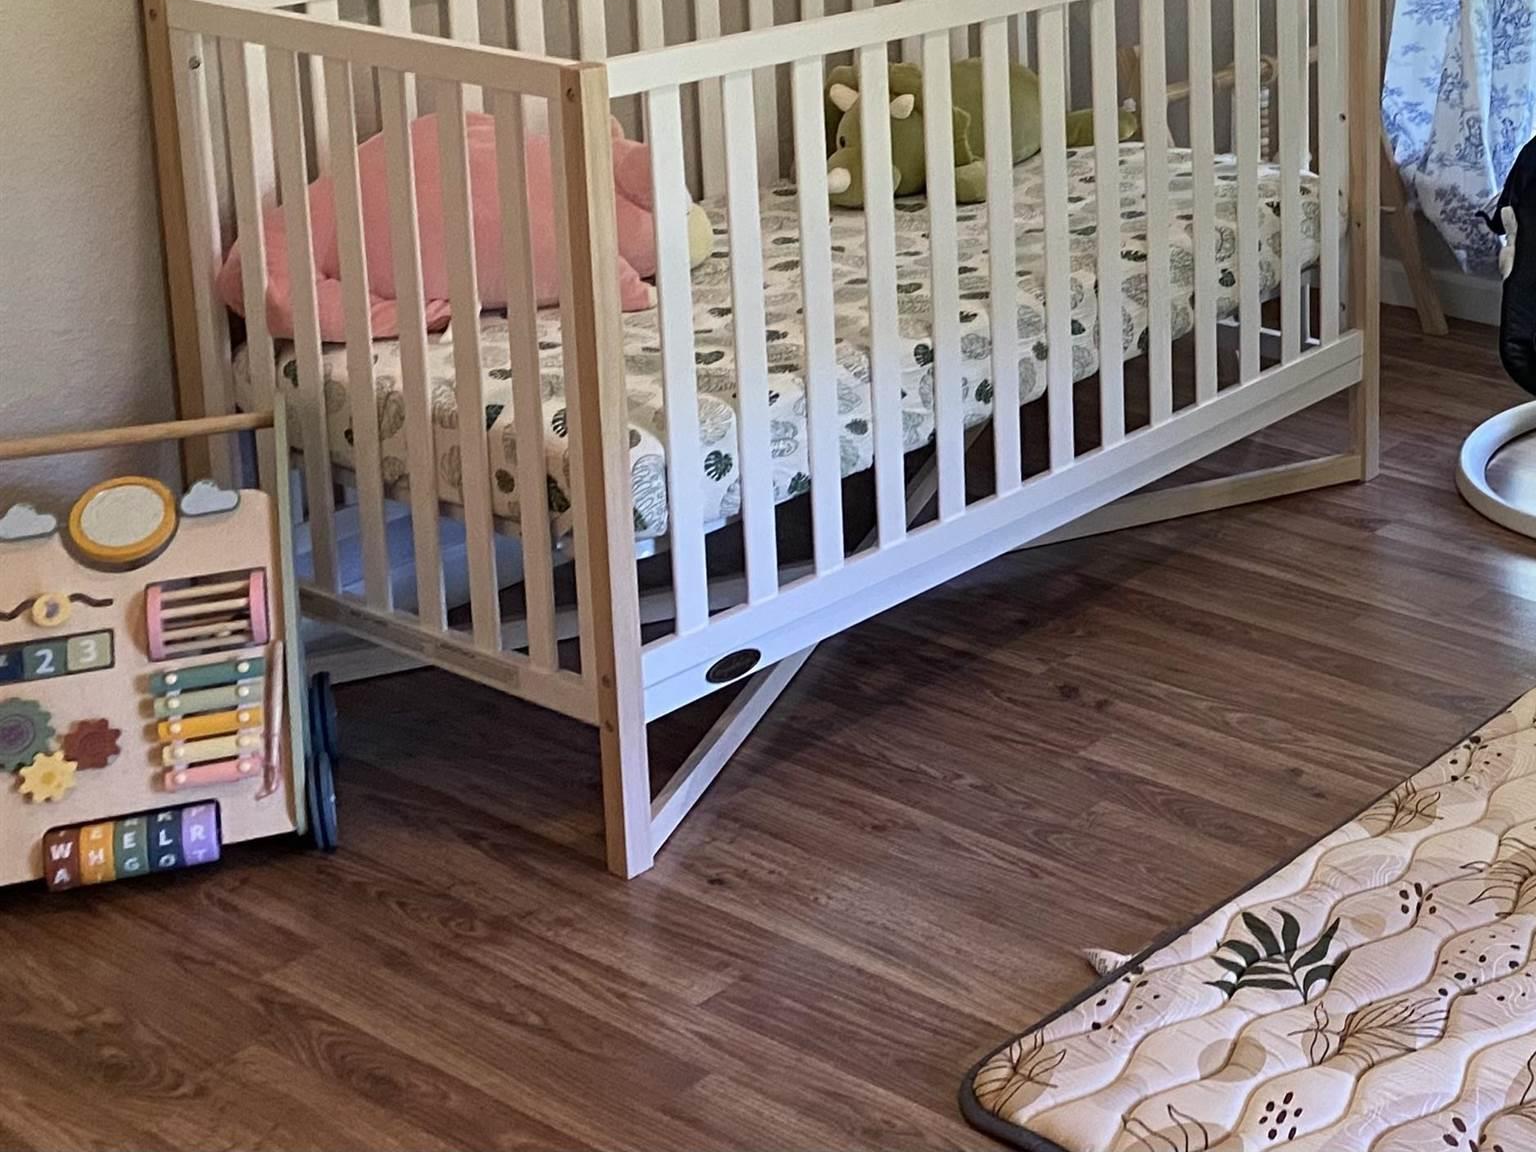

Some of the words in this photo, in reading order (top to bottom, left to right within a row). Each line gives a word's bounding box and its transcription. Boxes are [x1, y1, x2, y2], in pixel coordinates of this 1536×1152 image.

[34, 648, 56, 674] 2
[79, 639, 97, 663] 3
[50, 841, 73, 861] W
[123, 830, 137, 849] E
[159, 828, 173, 847] L
